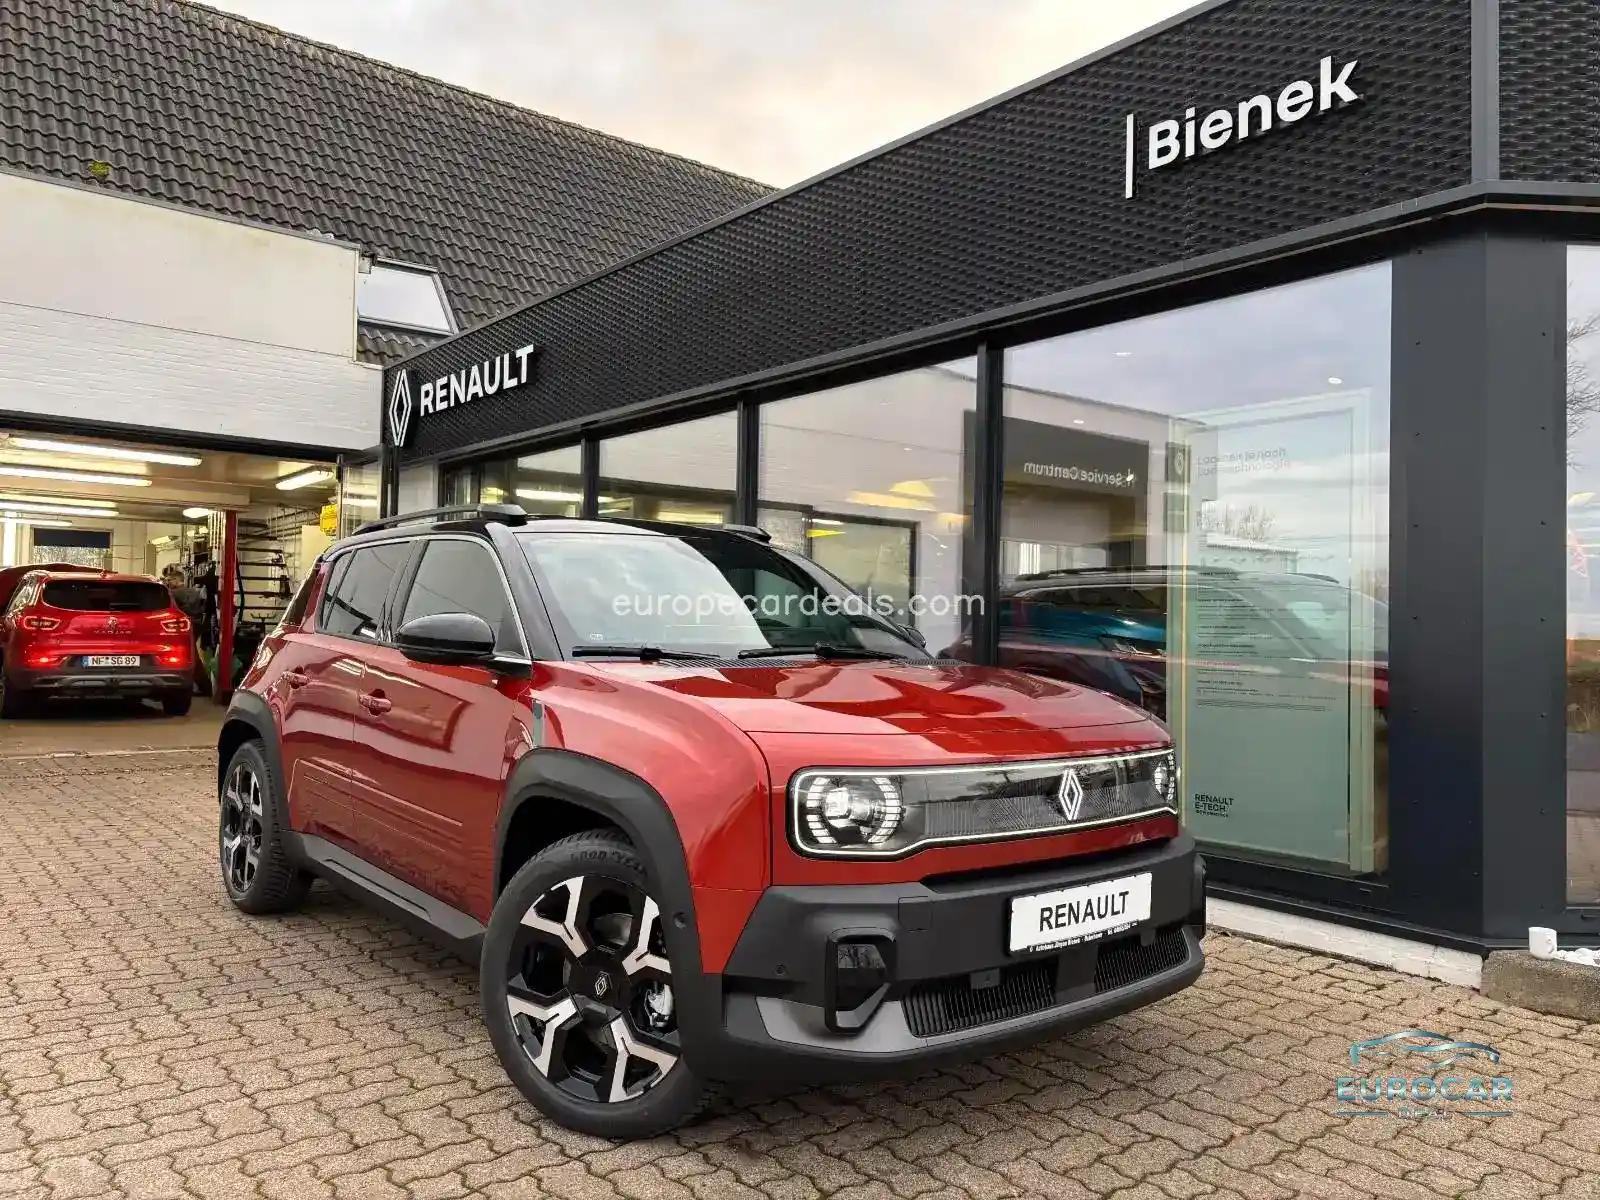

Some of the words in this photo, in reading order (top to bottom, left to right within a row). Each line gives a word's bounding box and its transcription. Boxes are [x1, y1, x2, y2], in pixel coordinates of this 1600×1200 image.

[1148, 55, 1359, 170] Bienek
[420, 344, 534, 417] RENAULT
[92, 656, 105, 665] NF
[110, 656, 123, 665] SG
[124, 656, 136, 665] 89
[1194, 793, 1234, 806] RENAULT
[1194, 801, 1226, 812] E-TECH
[1039, 890, 1130, 932] RENAULT
